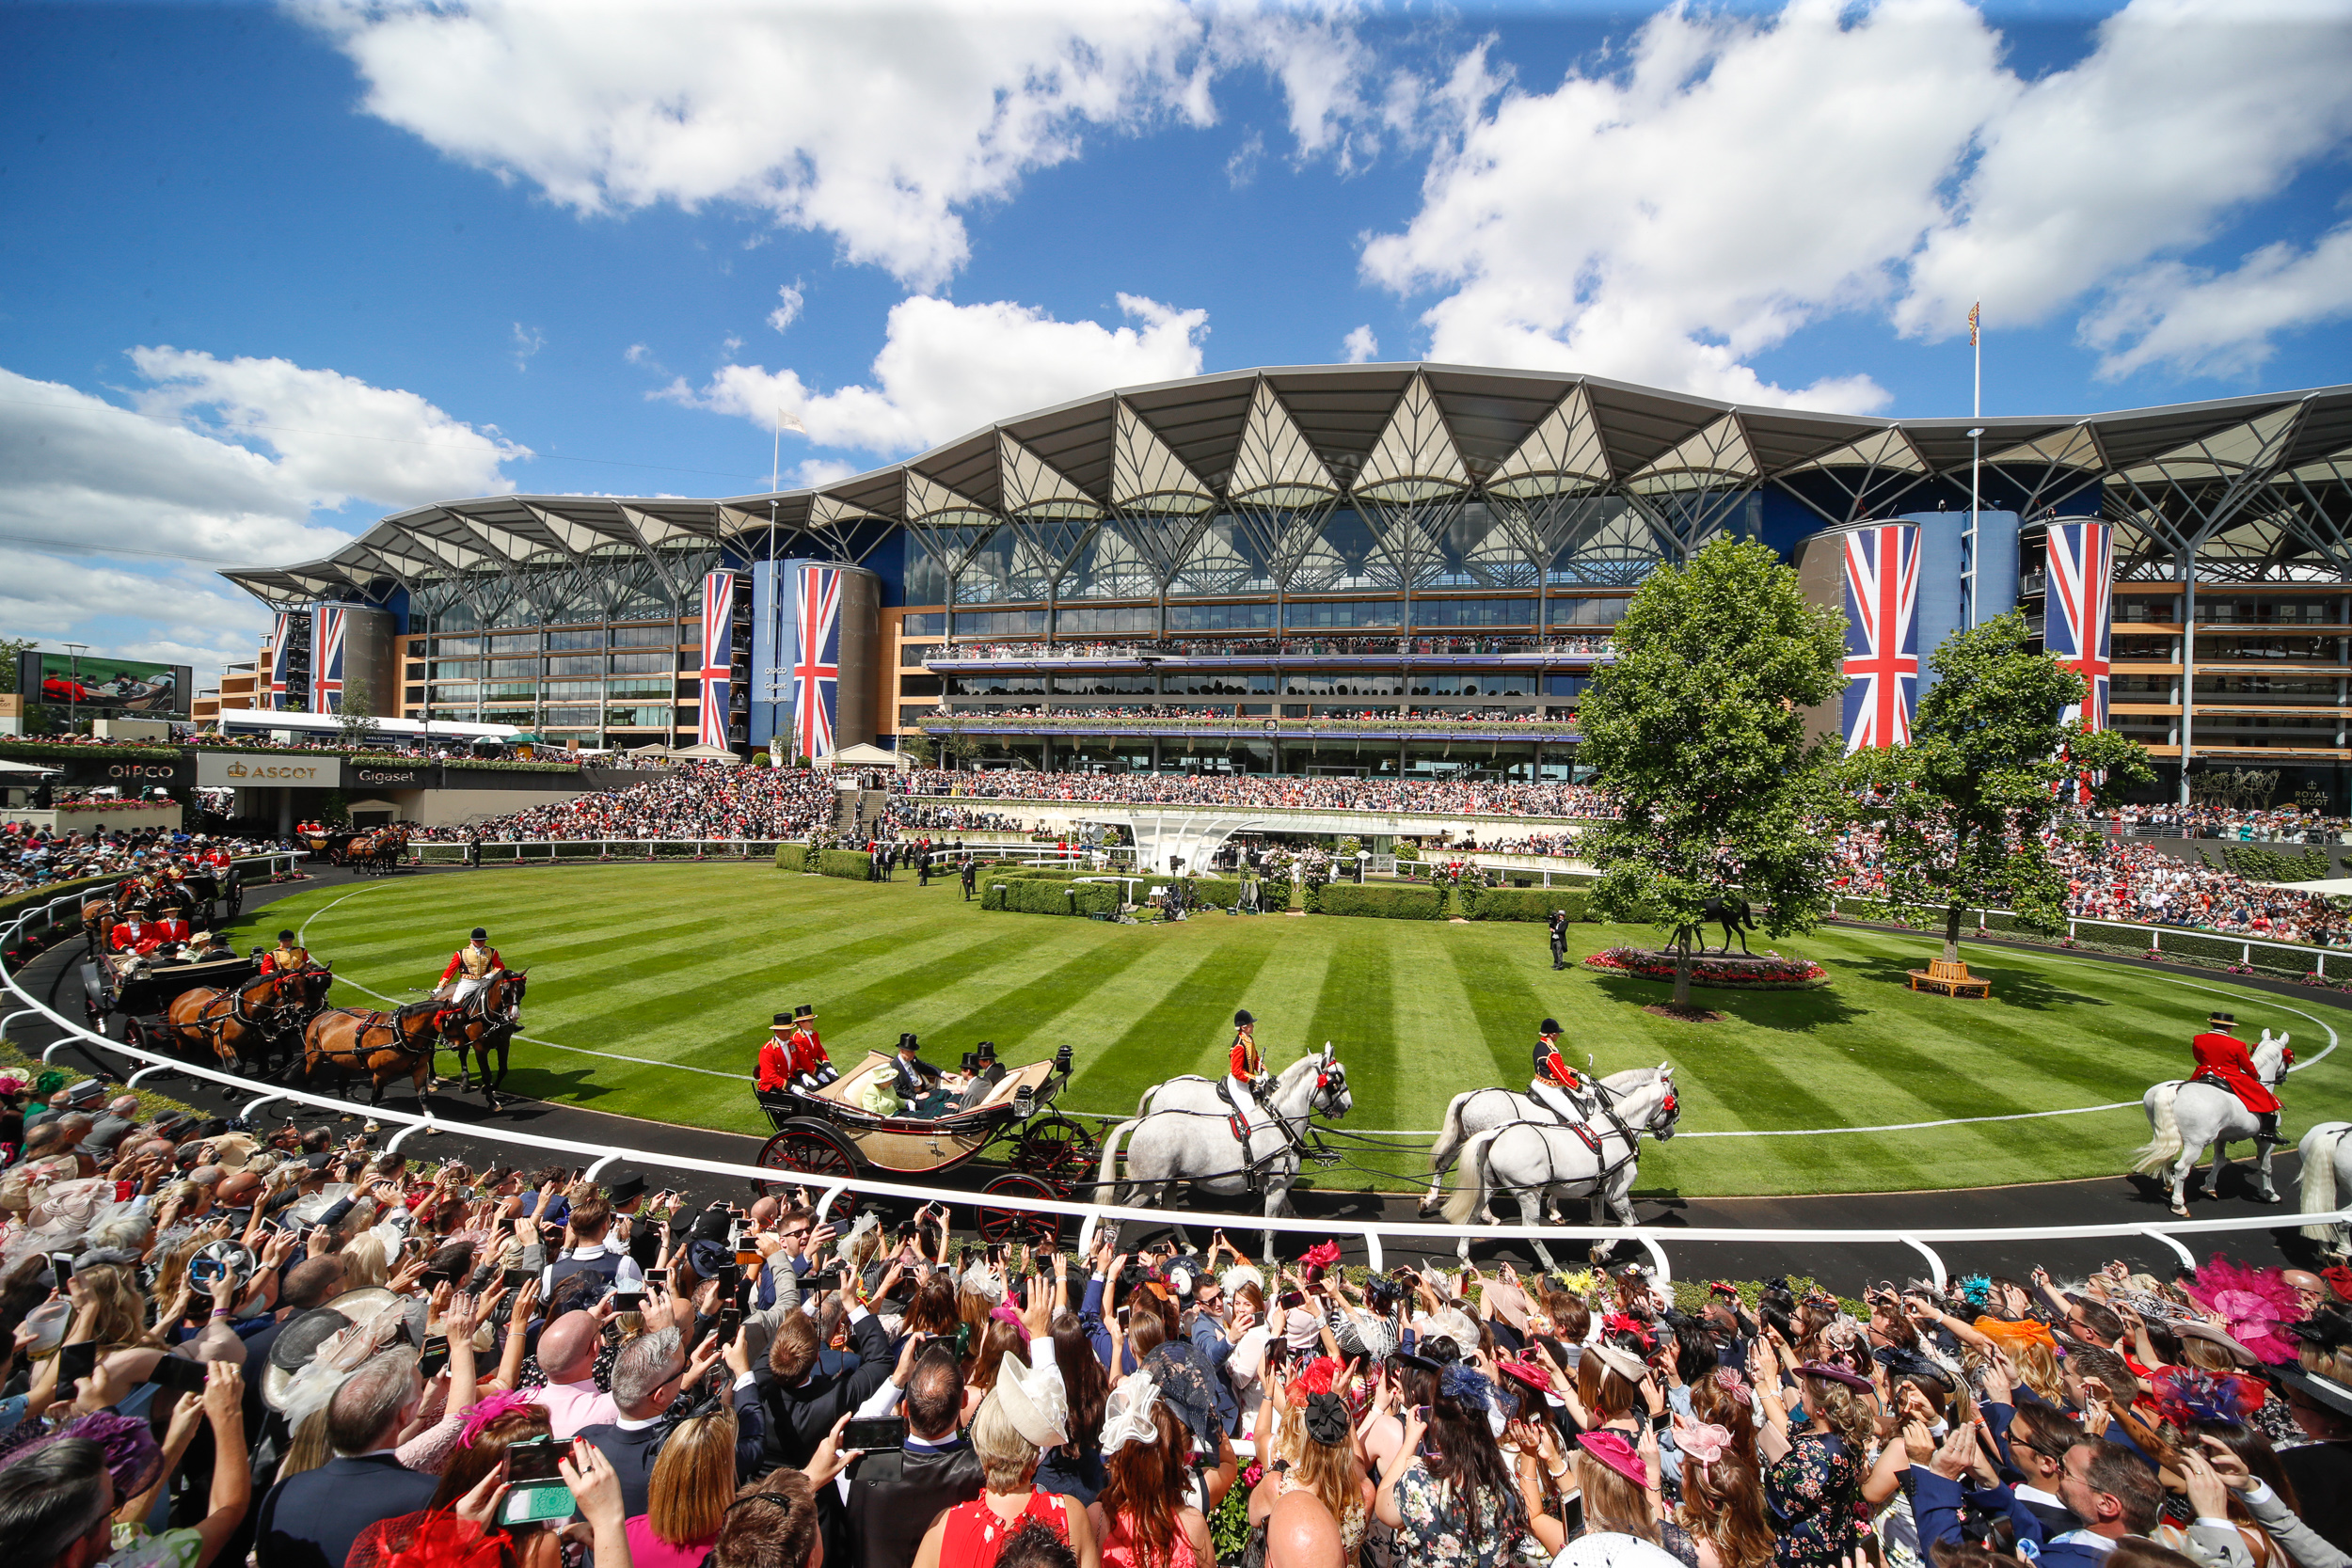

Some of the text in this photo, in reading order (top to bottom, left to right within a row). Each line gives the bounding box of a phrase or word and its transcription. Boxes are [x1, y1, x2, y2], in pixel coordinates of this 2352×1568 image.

[108, 765, 174, 779] QIPCO
[252, 767, 317, 779] ASCOT
[359, 770, 415, 784] Gigaset
